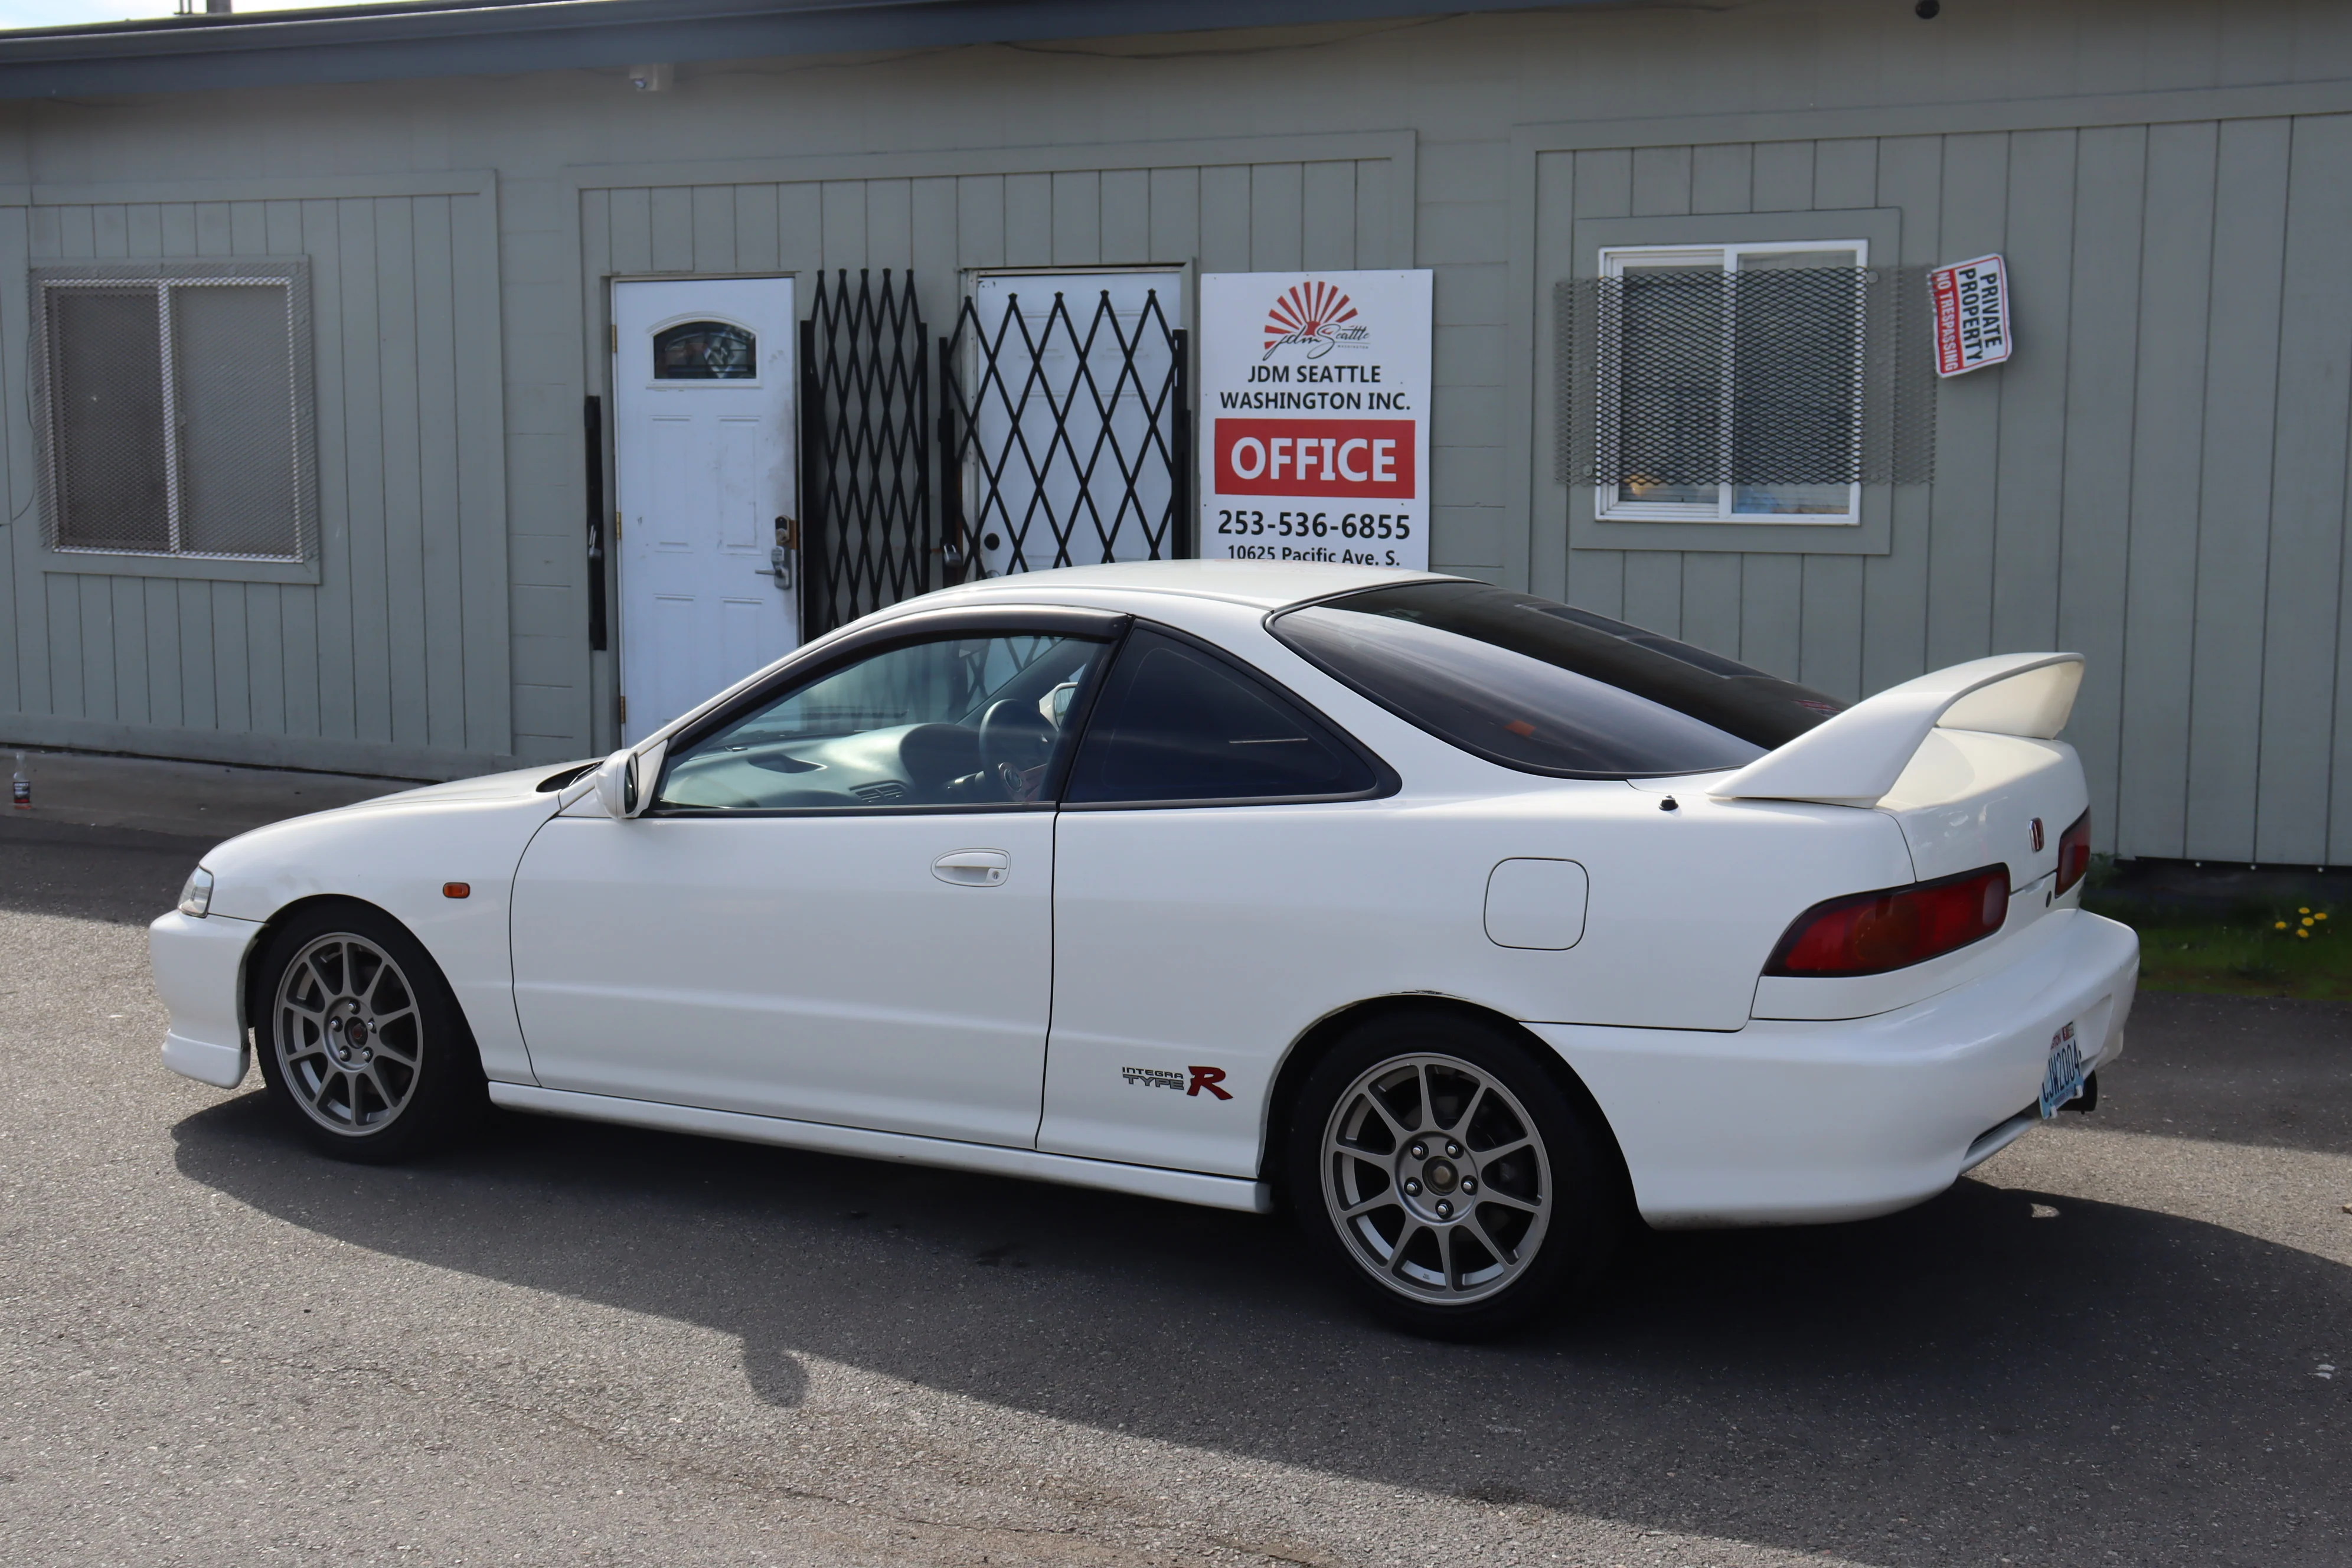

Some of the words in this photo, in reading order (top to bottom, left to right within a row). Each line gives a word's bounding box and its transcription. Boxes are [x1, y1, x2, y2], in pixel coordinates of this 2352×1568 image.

[1936, 272, 1952, 289] NO
[1959, 267, 1983, 361] PROPERTY
[1980, 272, 2003, 348] PRIVATE
[1307, 324, 1370, 360] Seattle
[1940, 291, 1959, 371] TRESPASSING
[1248, 366, 1290, 383] JDM
[1297, 365, 1381, 383] SEATTLE
[1220, 392, 1361, 410] WASHINGTON
[1368, 393, 1411, 411] INC.
[1231, 437, 1397, 482] OFFICE
[1218, 510, 1410, 540] 253-536-6855
[1228, 545, 1276, 560] 10625
[1283, 547, 1337, 563] Pacific
[1342, 550, 1380, 566] Ave.
[1386, 550, 1400, 567] S.
[1122, 1066, 1184, 1079] INTEGRA
[1123, 1074, 1184, 1090] TYPE
[1186, 1066, 1234, 1100] R
